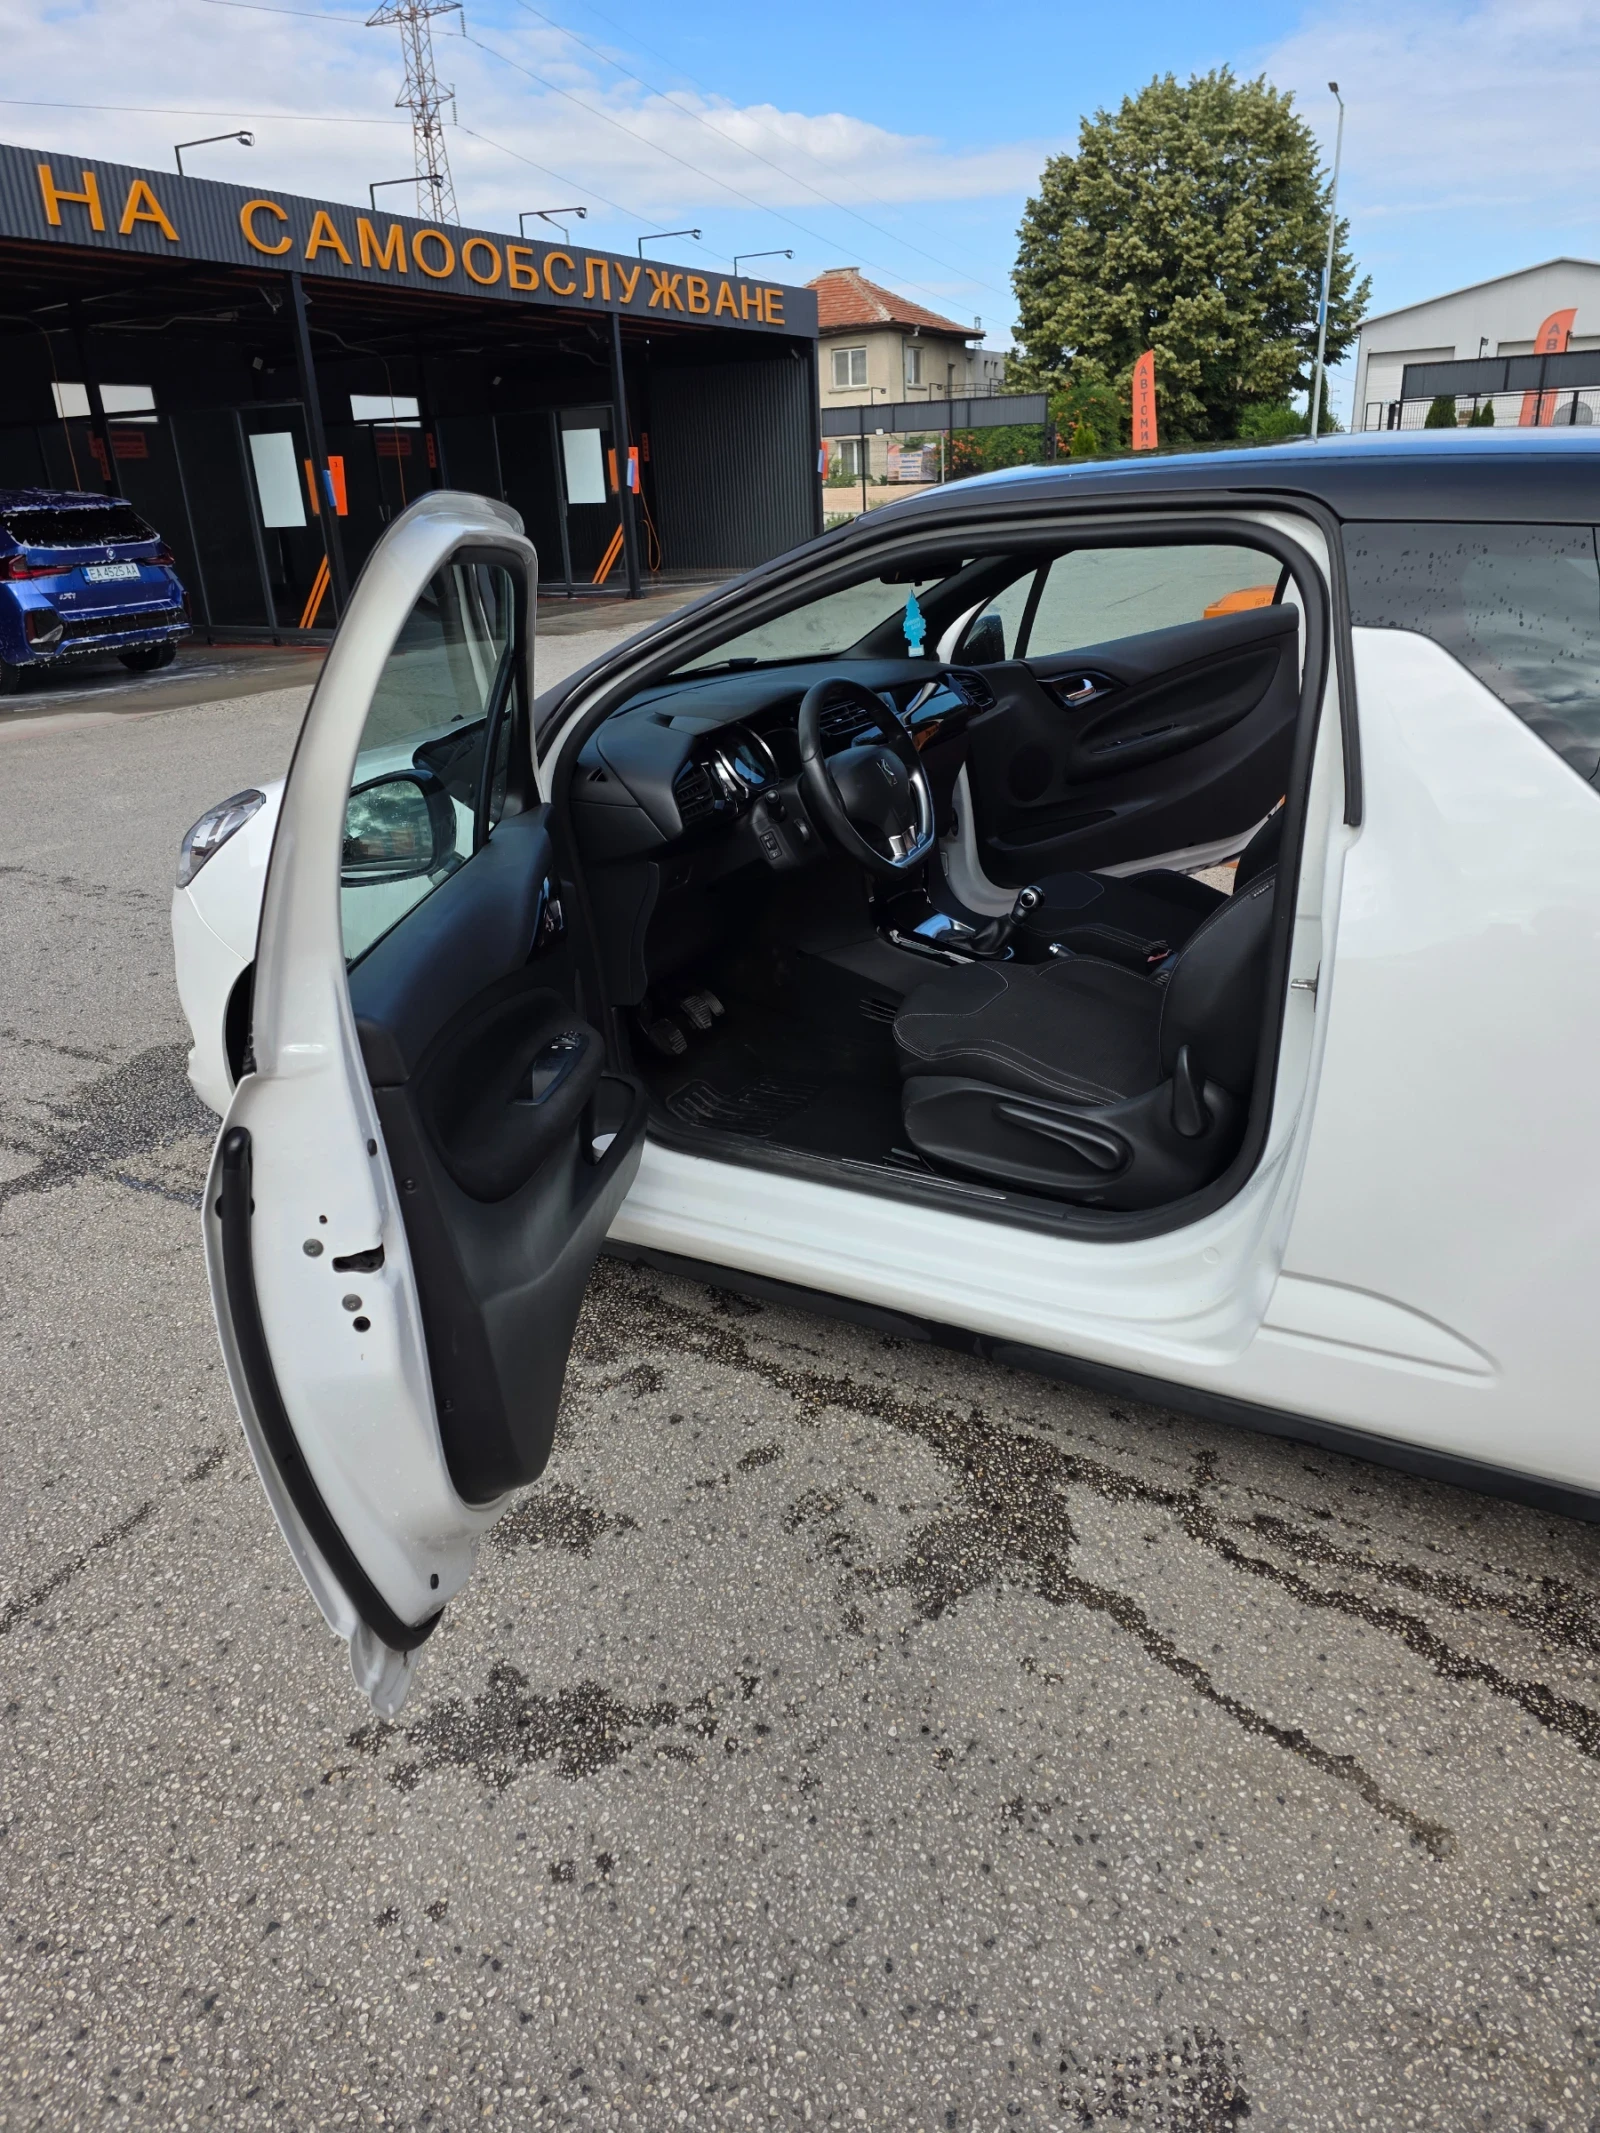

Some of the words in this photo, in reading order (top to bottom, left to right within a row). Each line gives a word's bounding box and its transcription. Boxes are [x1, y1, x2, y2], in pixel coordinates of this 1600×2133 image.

[38, 164, 180, 241] НА
[240, 199, 786, 325] САМООБСЛУЖВАНЕ
[104, 565, 125, 578] 4525
[126, 565, 138, 576] AA
